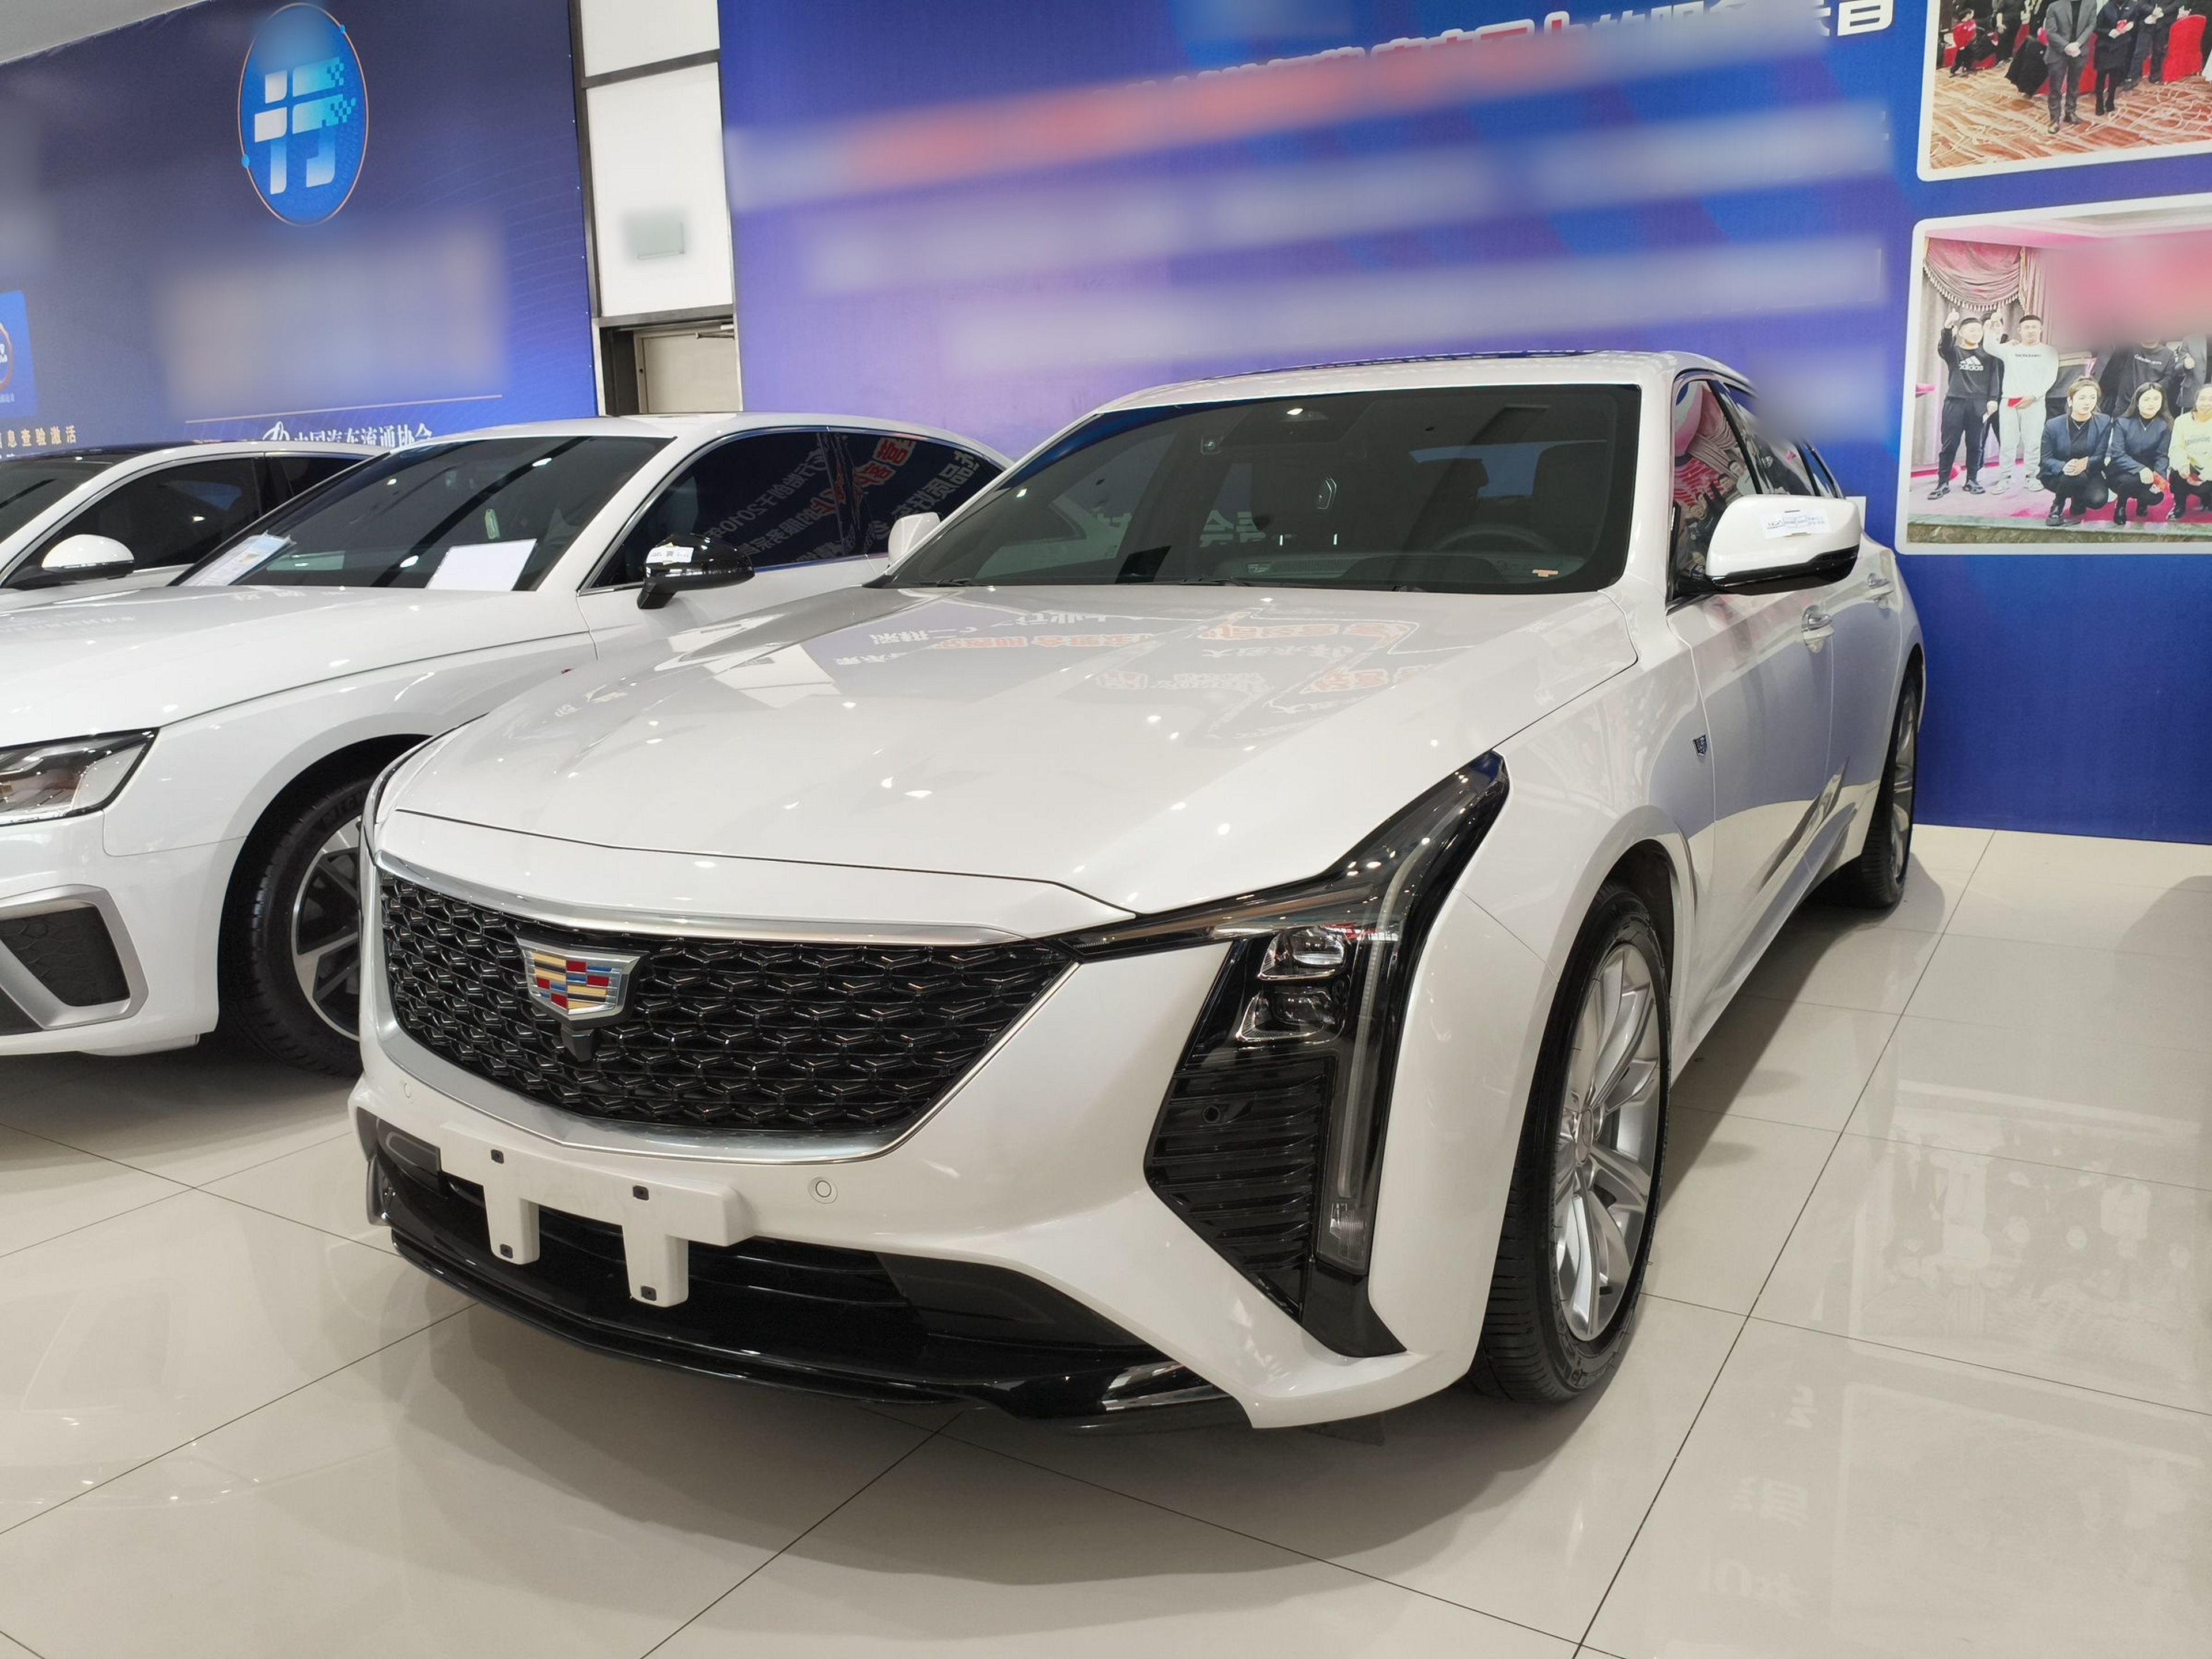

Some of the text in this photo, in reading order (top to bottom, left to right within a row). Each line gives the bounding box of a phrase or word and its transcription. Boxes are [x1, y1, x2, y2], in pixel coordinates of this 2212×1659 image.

[0, 425, 76, 448] 息查验激活
